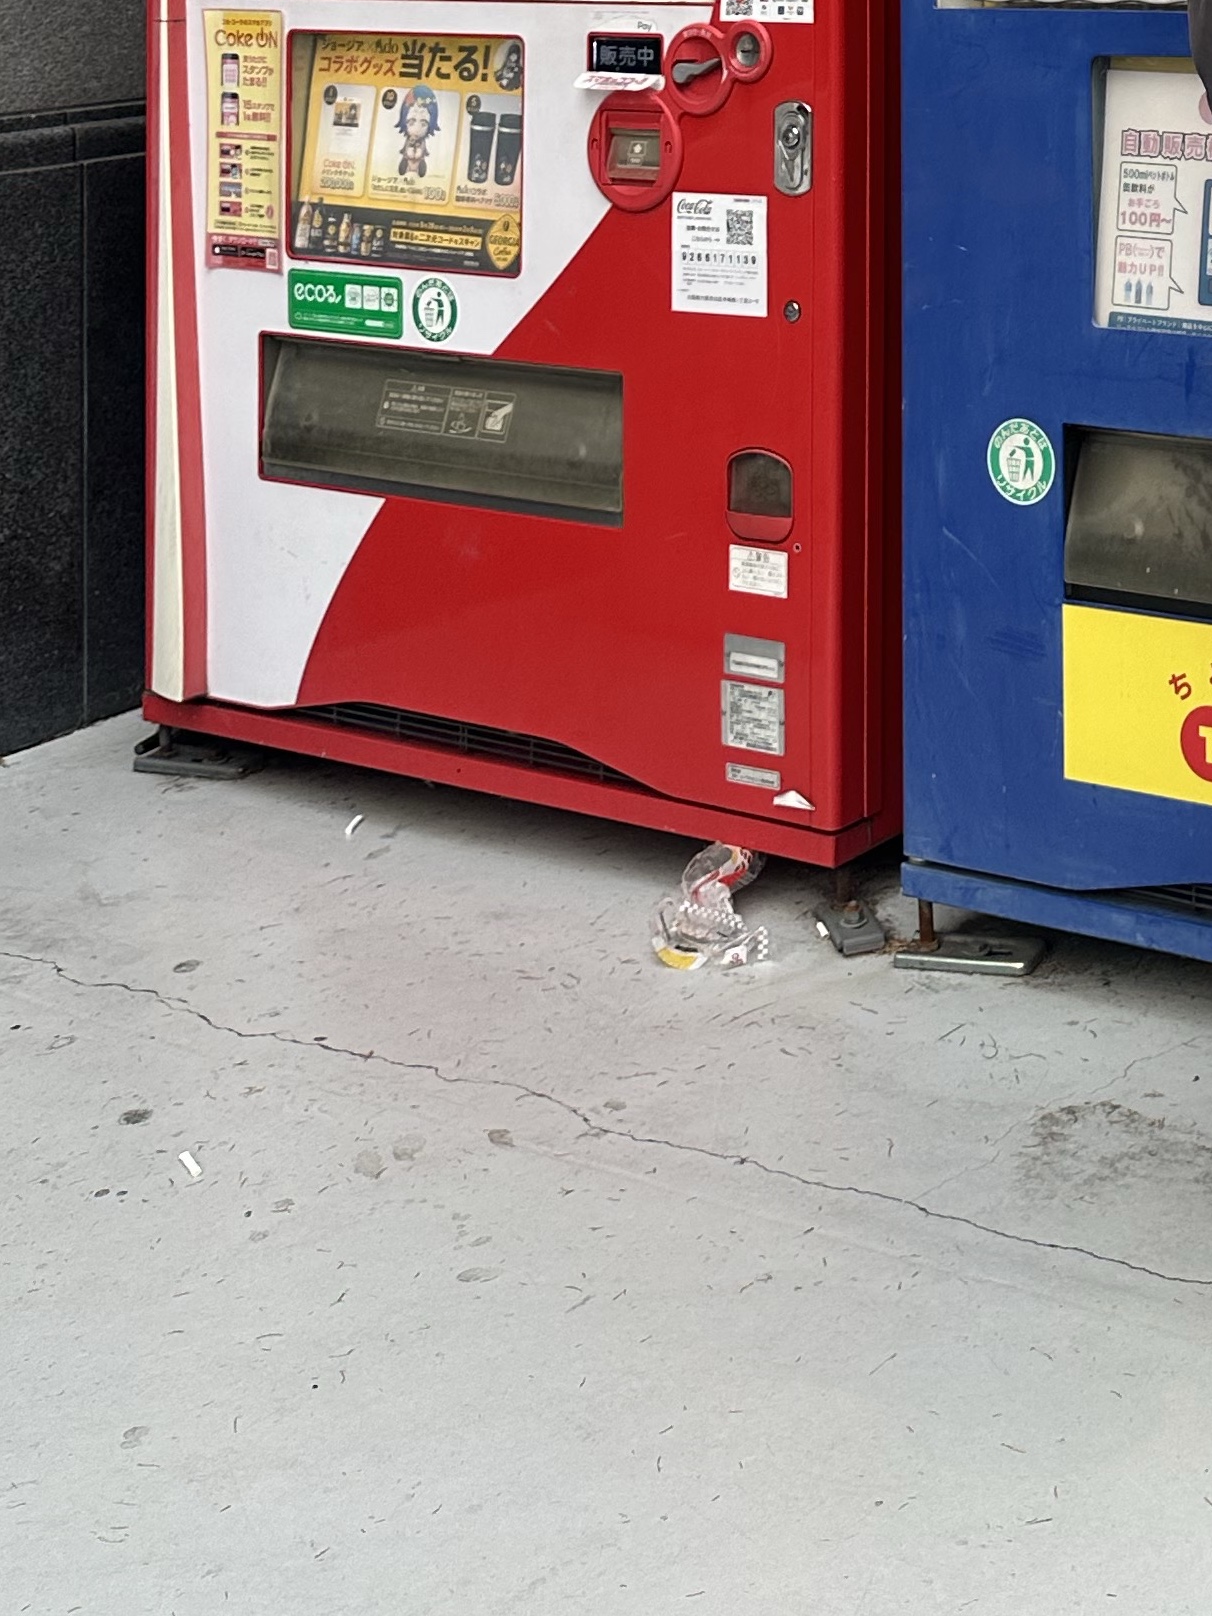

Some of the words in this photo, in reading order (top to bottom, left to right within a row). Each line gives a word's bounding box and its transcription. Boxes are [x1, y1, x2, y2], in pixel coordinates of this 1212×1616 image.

[638, 21, 653, 31] Pay
[214, 29, 253, 48] Coke
[255, 27, 278, 48] ON
[318, 56, 398, 75] コラボグッズ
[399, 41, 490, 82] 当たる!
[600, 45, 654, 66] 販売中
[995, 472, 1048, 502] リサイクル
